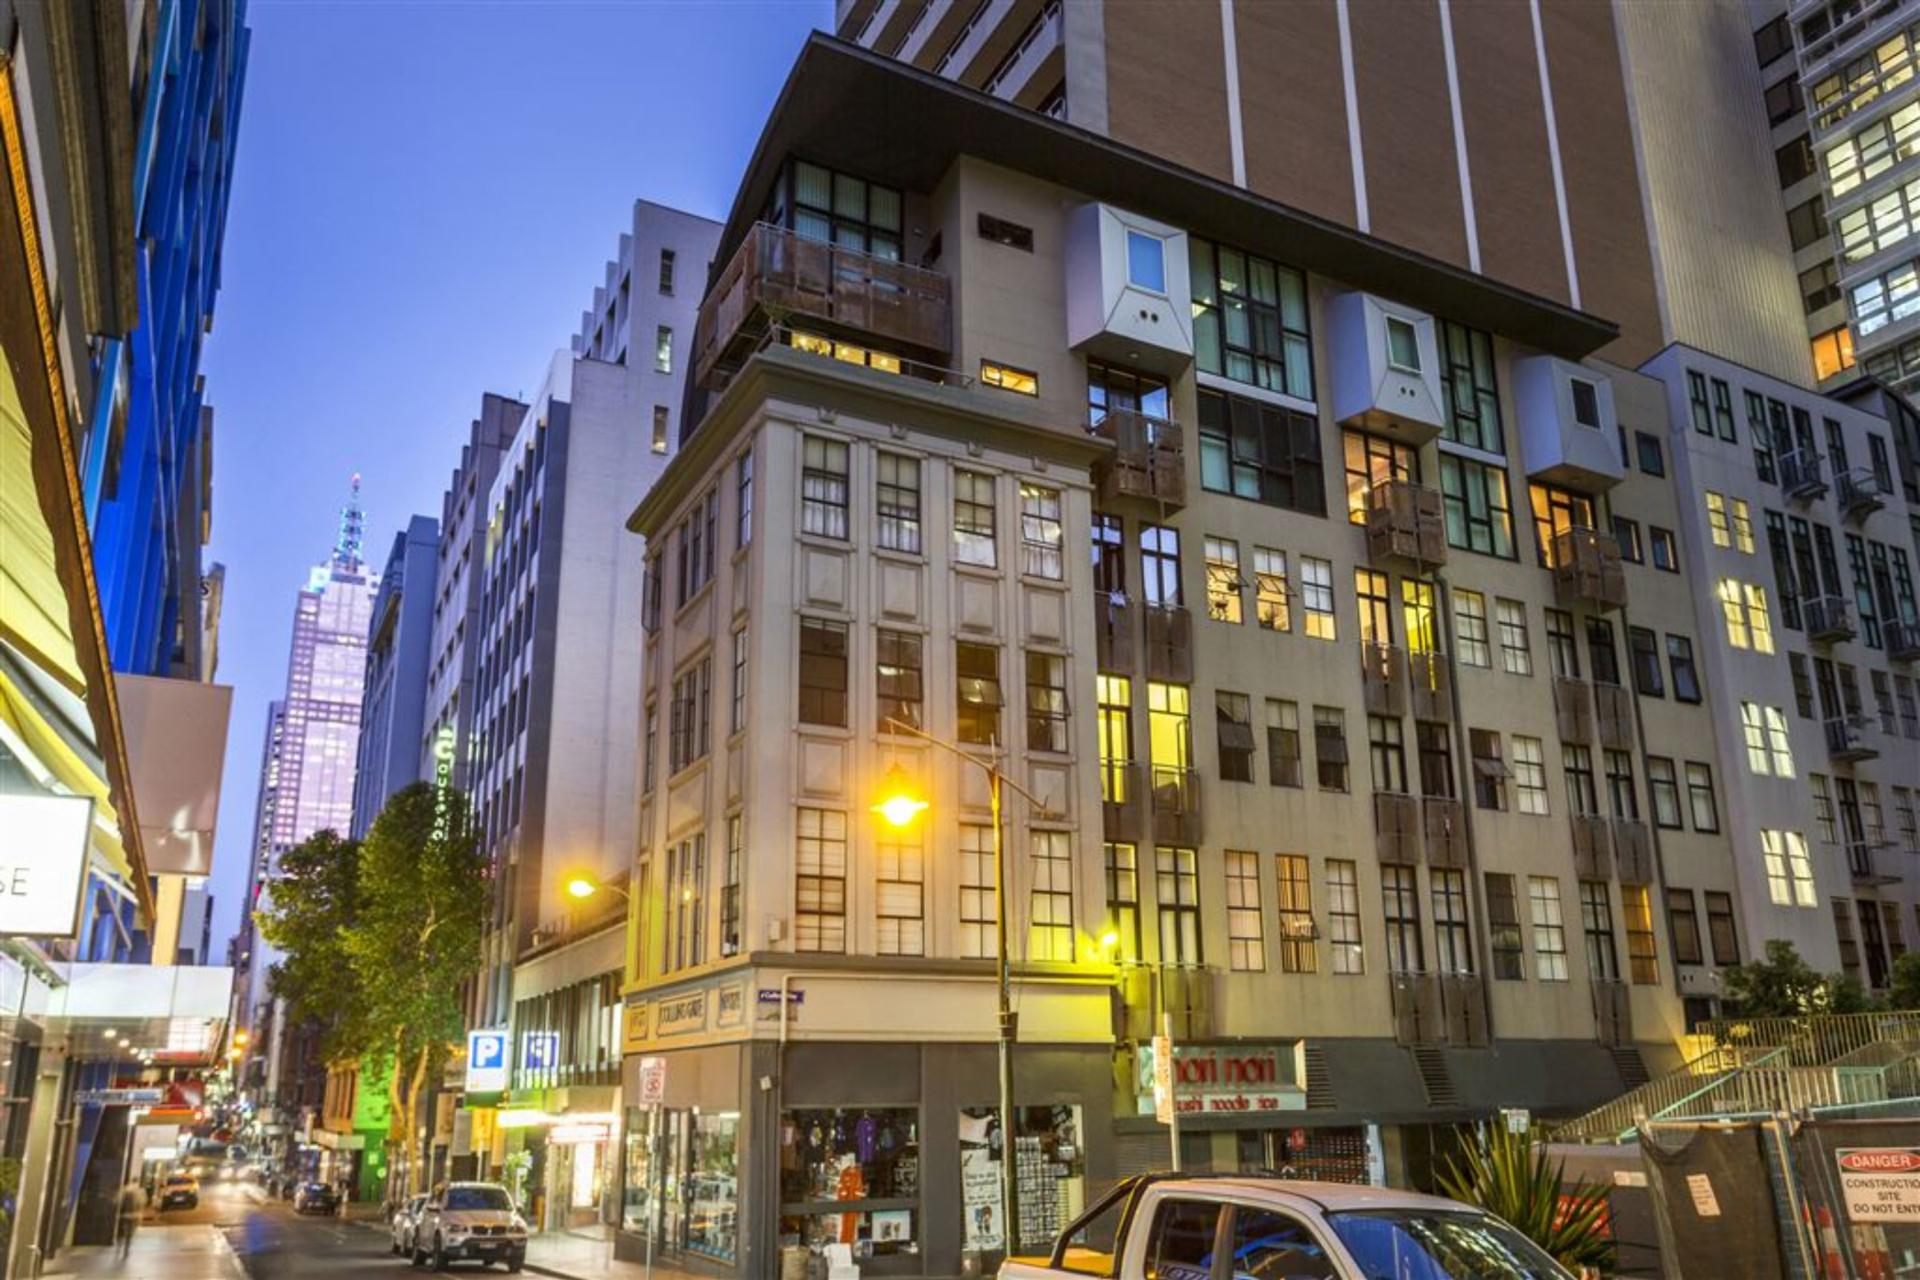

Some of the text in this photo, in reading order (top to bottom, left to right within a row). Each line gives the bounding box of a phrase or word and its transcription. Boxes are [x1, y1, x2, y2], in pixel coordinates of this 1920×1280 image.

[475, 1036, 500, 1067] P
[1177, 1097, 1204, 1112] ushi
[1851, 1154, 1911, 1168] DANGER
[1877, 1191, 1901, 1201] SITE
[1854, 1204, 1870, 1214] DO
[1872, 1204, 1893, 1214] NOT
